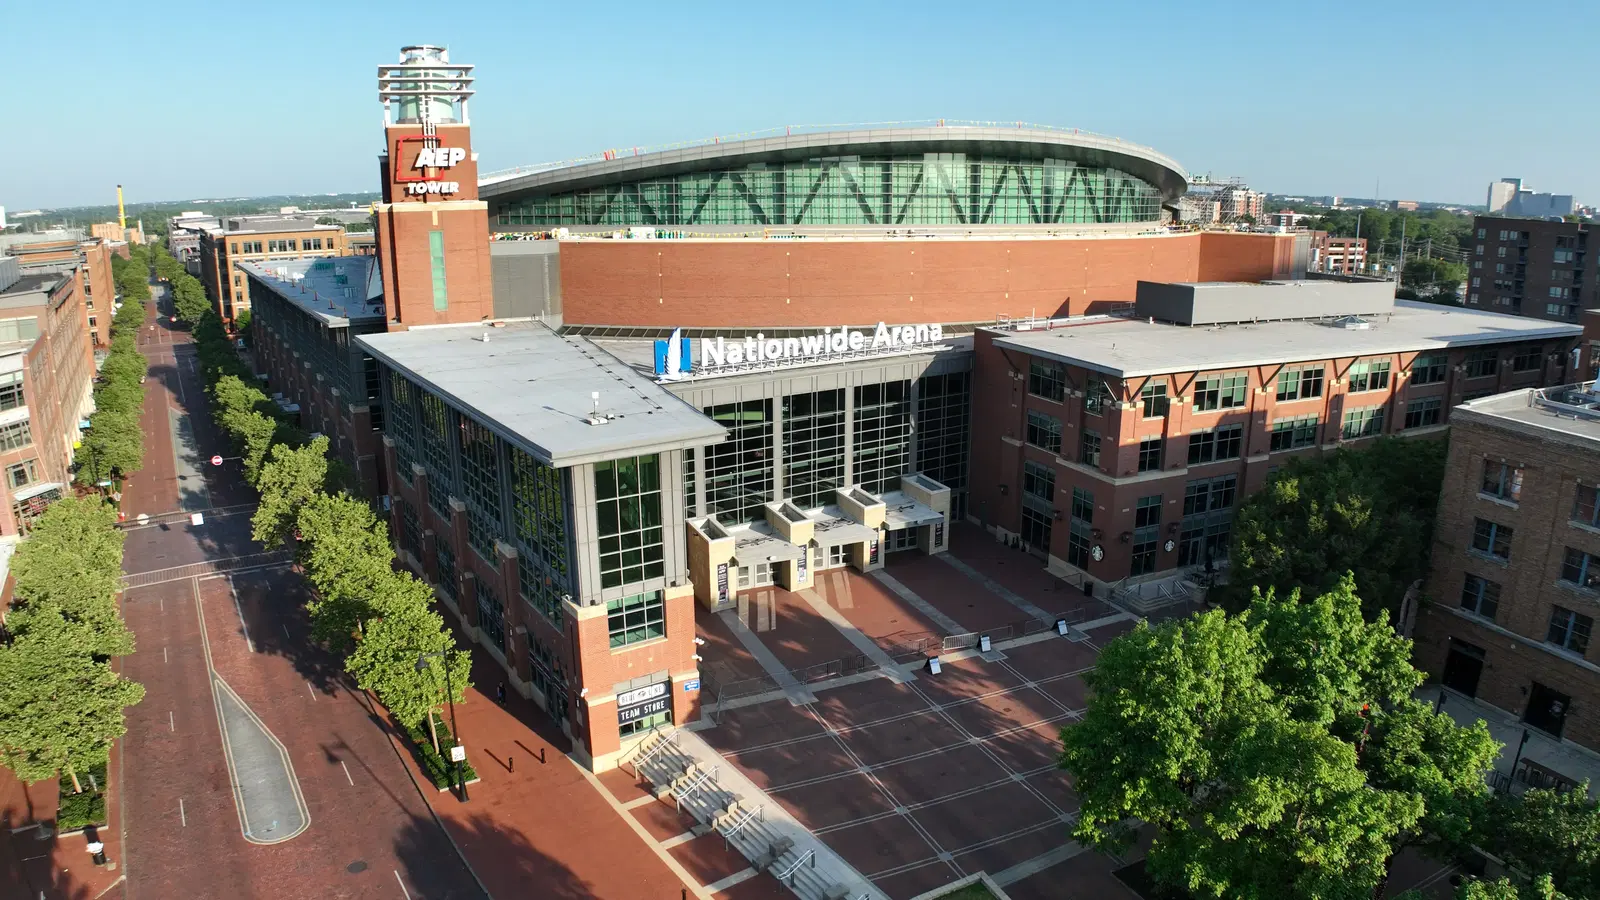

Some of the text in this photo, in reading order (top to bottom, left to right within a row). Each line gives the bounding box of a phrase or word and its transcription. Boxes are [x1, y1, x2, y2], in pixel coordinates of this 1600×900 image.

[415, 147, 466, 168] AEP
[407, 181, 460, 195] TOWER
[701, 321, 943, 367] Nationwide Arena
[647, 686, 663, 697] LNE
[621, 700, 665, 721] TEAM STORE
